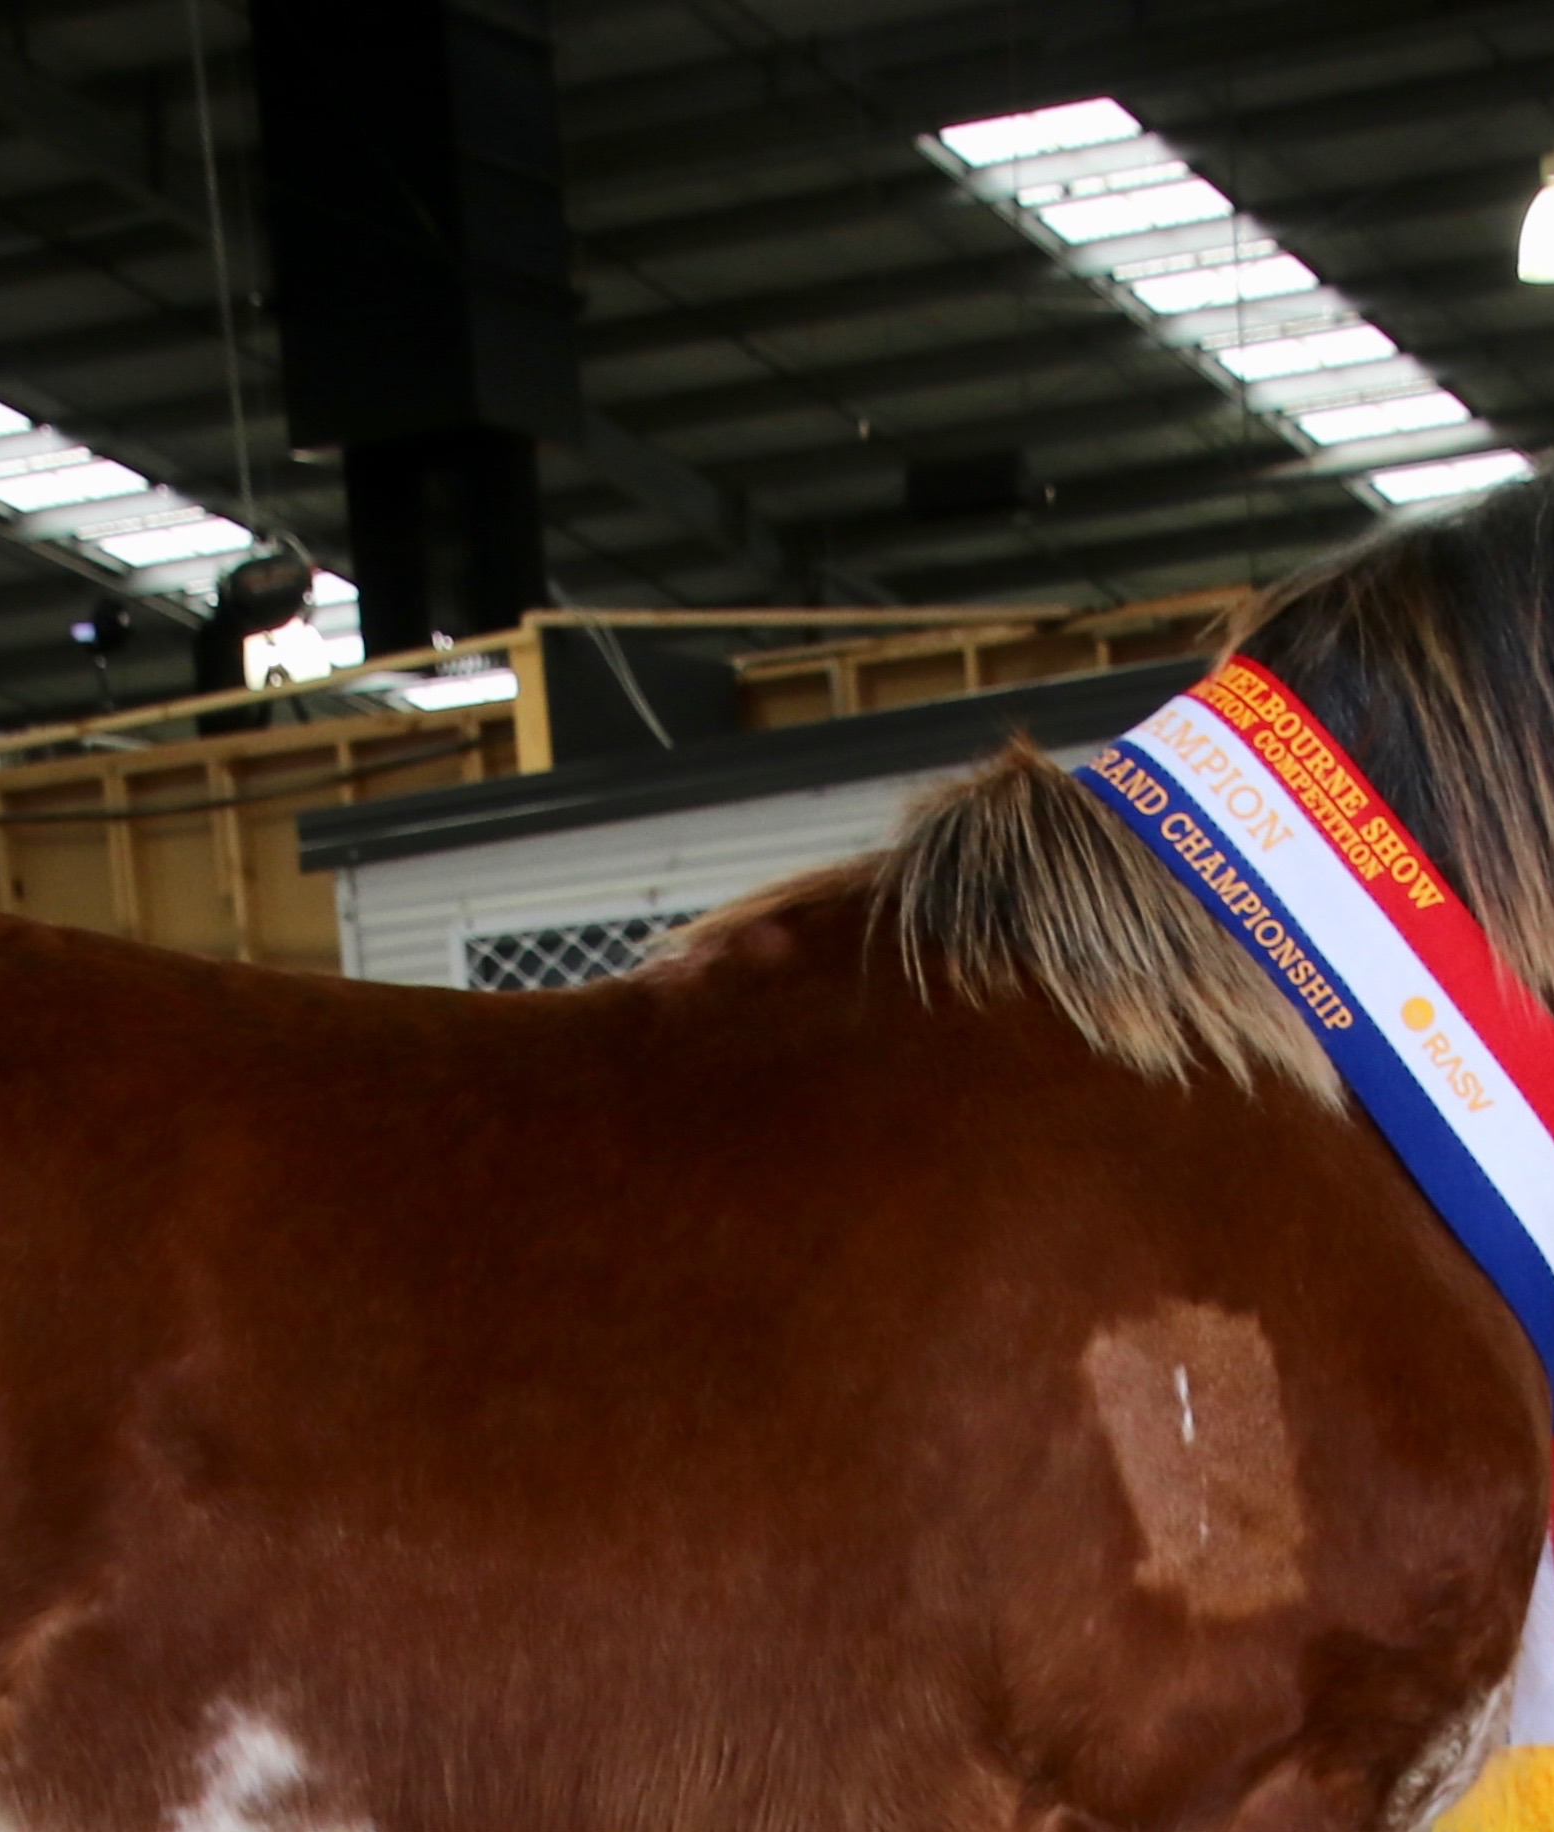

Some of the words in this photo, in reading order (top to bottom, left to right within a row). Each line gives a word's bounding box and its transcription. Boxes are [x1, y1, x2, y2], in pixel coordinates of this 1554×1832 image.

[1252, 728, 1386, 882] COMPETITION
[1359, 815, 1446, 910] SHOW
[1160, 811, 1354, 1031] CHAMPIONSHIP
[1422, 1031, 1495, 1113] RASV
